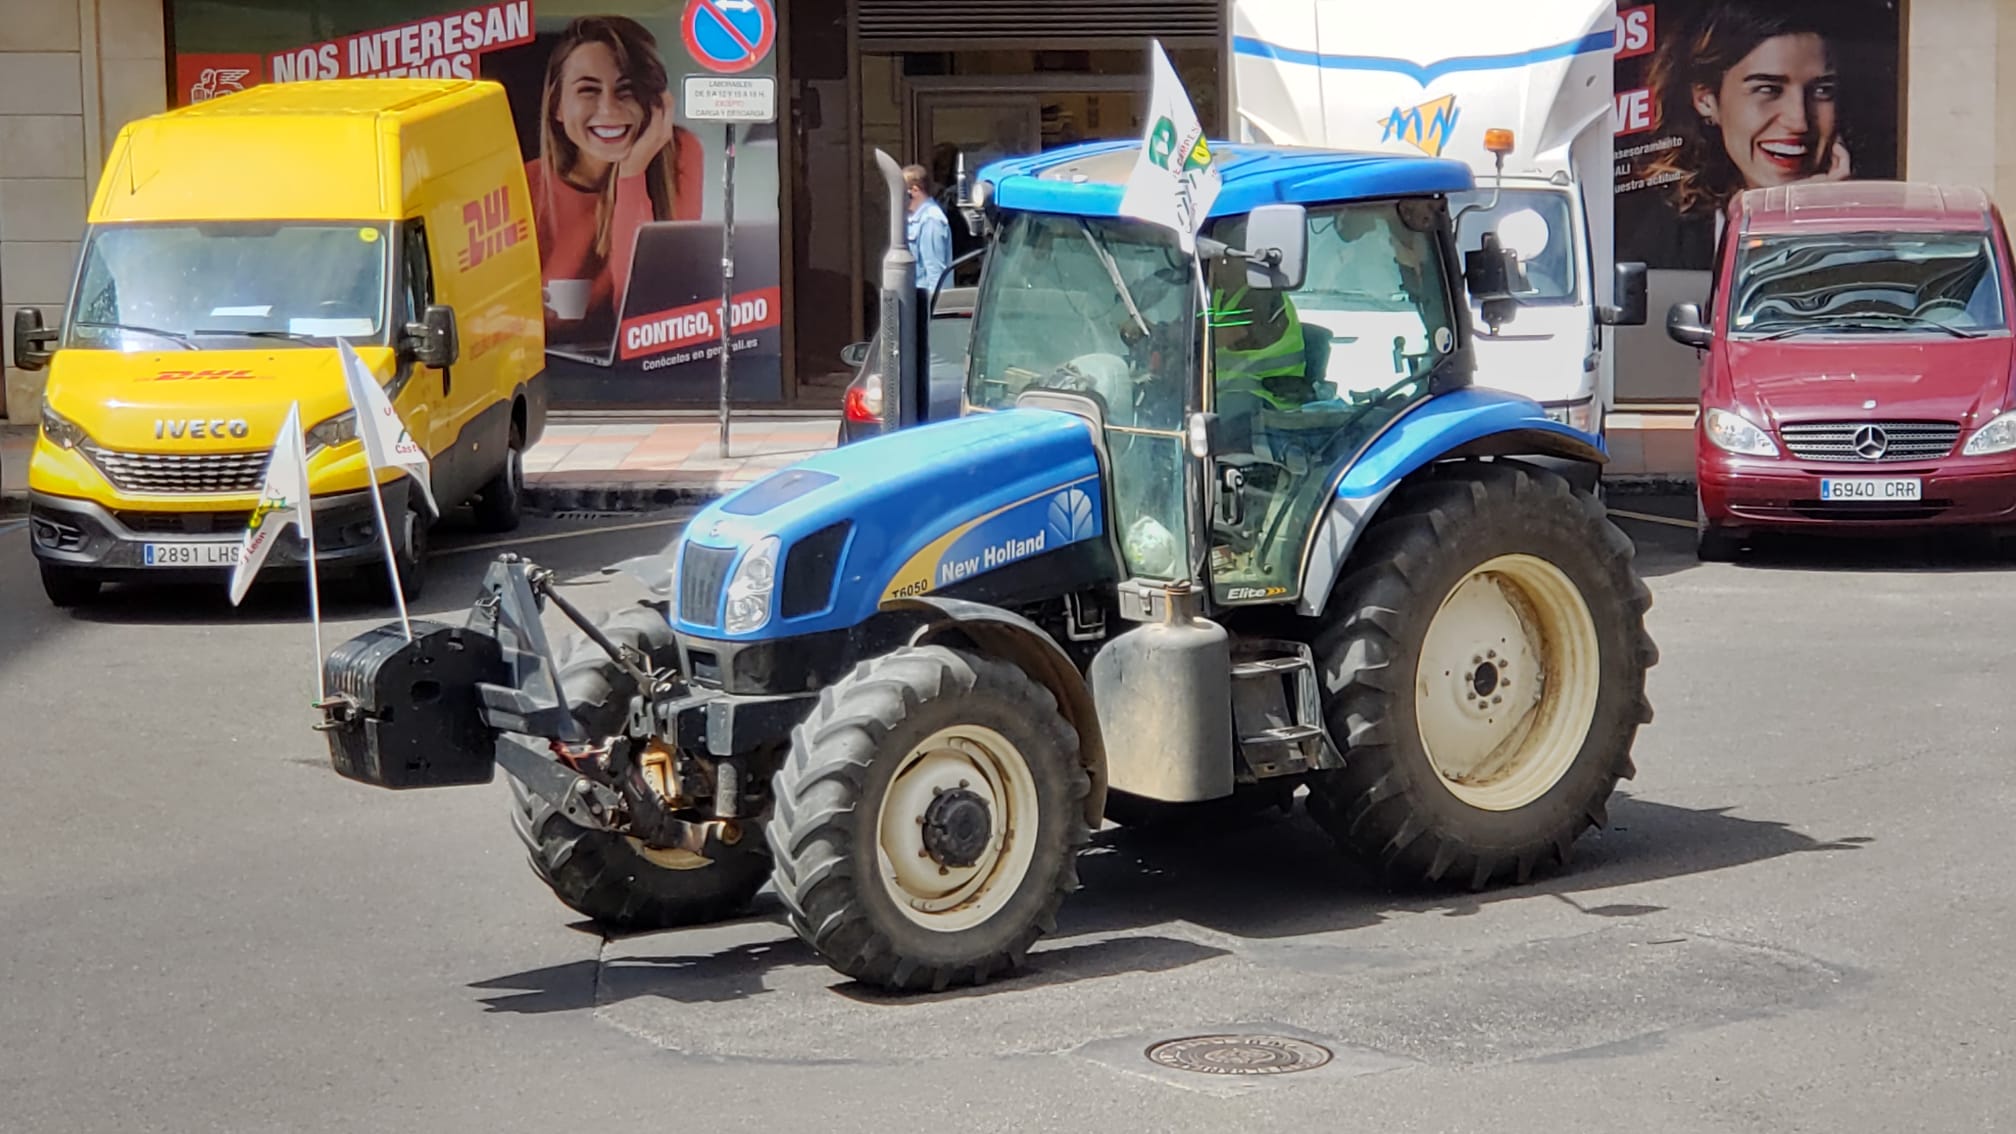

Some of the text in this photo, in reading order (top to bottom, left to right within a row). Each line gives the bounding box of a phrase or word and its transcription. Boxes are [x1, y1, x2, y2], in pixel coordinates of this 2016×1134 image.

[273, 2, 529, 83] NOS INTERESAN
[462, 184, 522, 270] DHL
[628, 311, 713, 349] CONTIGO,
[643, 352, 690, 371] Conócelos
[692, 350, 704, 361] en
[154, 369, 256, 381] DHL
[155, 418, 249, 440] IVECO
[1832, 482, 1915, 497] 6940 CRR
[158, 546, 239, 563] 2891 LHS
[942, 530, 1045, 583] New Holland
[892, 579, 928, 598] T6050
[1227, 587, 1267, 600] Elite
